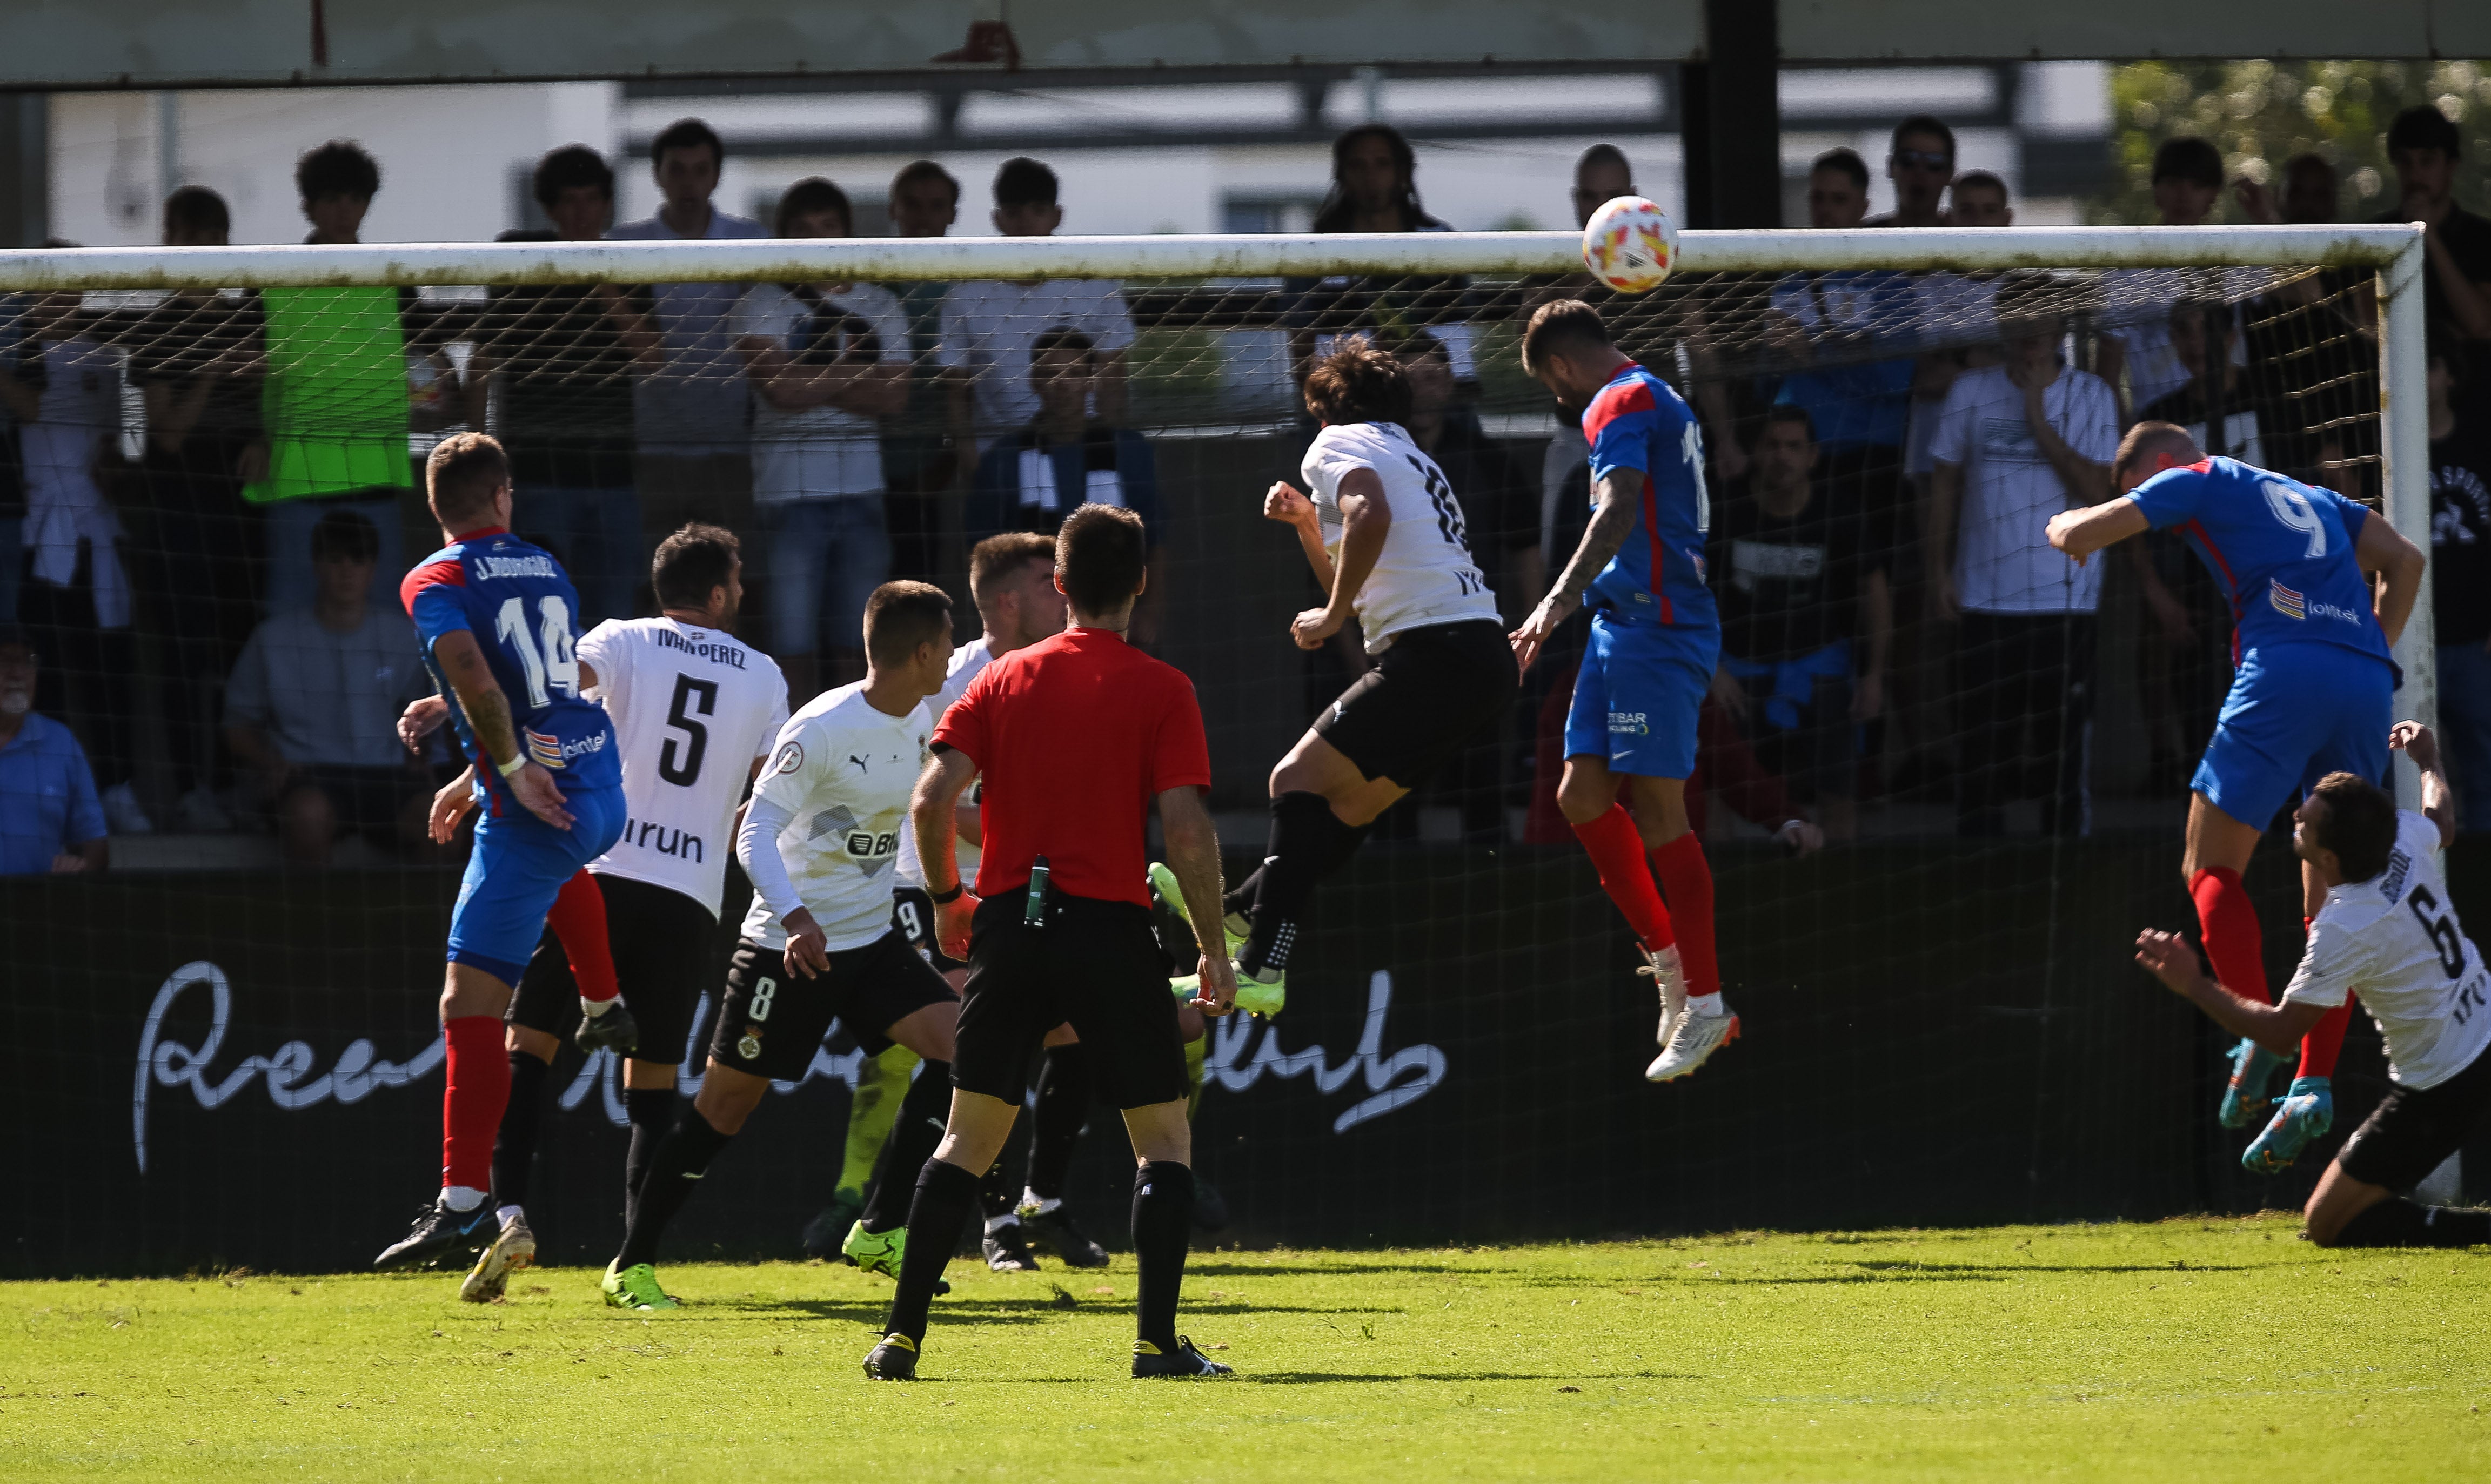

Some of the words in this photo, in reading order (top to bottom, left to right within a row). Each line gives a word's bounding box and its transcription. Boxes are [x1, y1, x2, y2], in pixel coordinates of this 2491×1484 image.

[1680, 421, 1710, 533] 1
[2261, 479, 2327, 559] 9
[494, 595, 579, 708] 14
[659, 672, 719, 787] 5
[896, 901, 923, 941] 9
[2408, 883, 2466, 979] 6
[749, 976, 776, 1022] 8
[133, 959, 446, 1177] Rea
[1202, 969, 1448, 1133] lub
